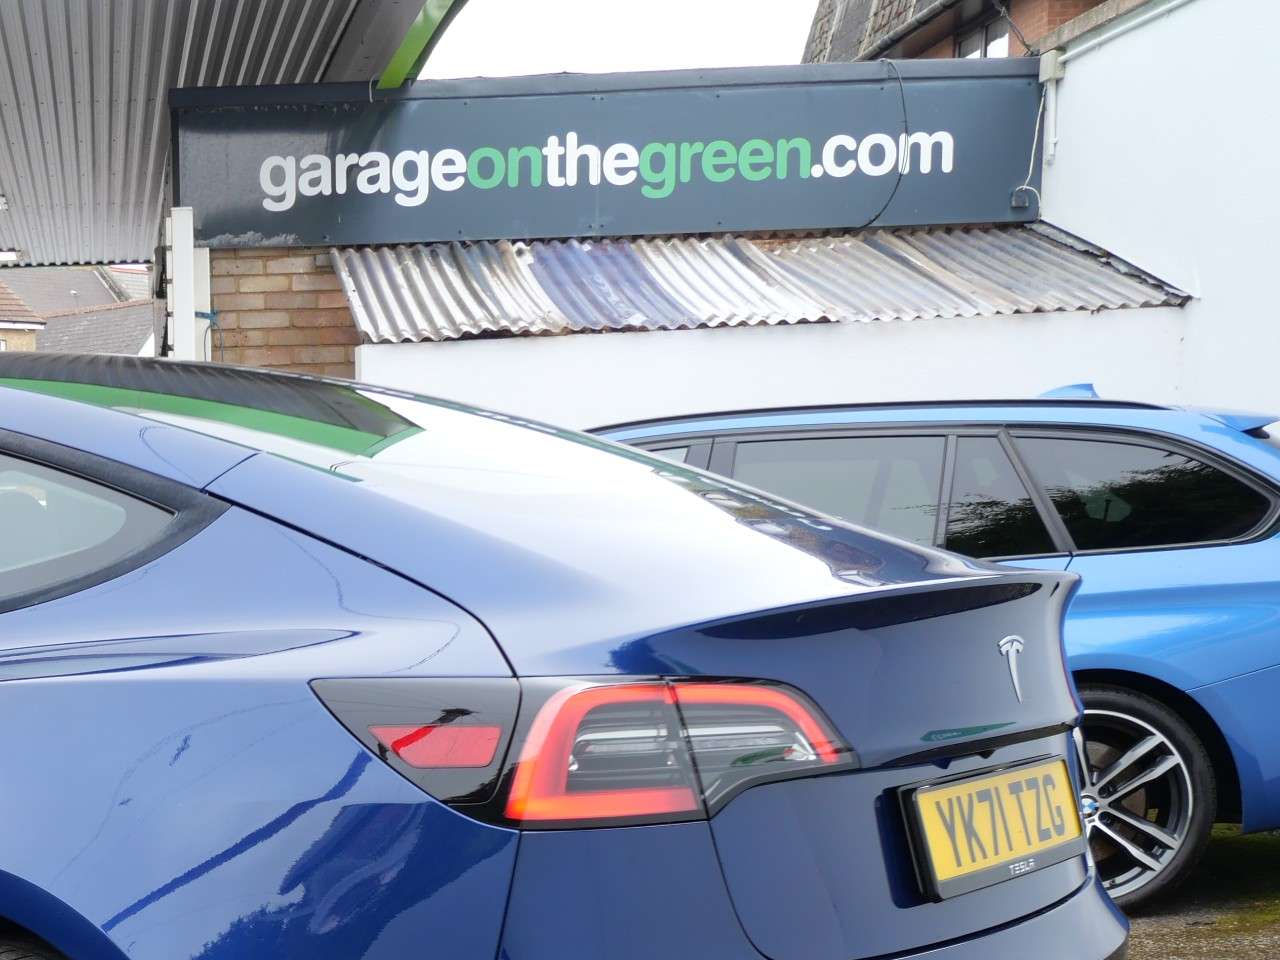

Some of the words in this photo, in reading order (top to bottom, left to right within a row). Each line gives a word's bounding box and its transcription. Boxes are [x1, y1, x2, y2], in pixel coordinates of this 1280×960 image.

[259, 130, 954, 212] garageonthegreen.com
[935, 786, 1013, 868] YK71
[1007, 773, 1065, 847] TZG
